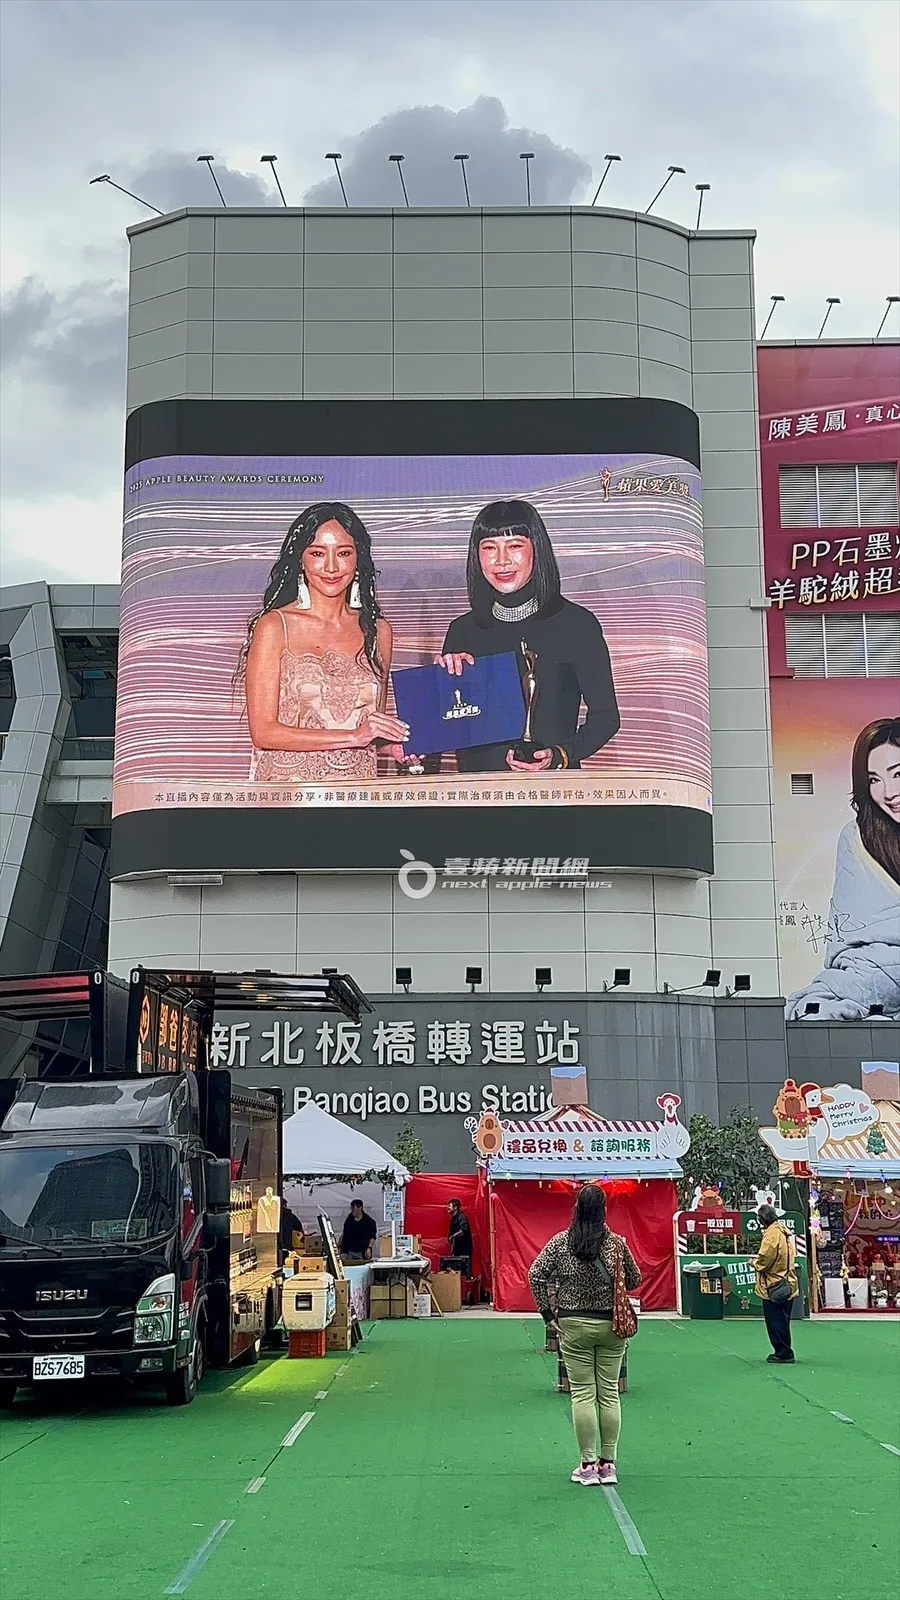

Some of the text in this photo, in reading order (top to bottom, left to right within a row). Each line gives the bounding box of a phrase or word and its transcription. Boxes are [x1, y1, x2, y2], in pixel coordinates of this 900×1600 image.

[145, 475, 172, 487] APPLE
[177, 474, 216, 483] BEAUTY
[220, 476, 263, 484] AWARDS
[267, 474, 324, 484] CEREMONY
[769, 566, 900, 610] 羊駝絨超
[779, 901, 809, 911] 代言人
[210, 1020, 580, 1067] 新北板橋轉運站
[293, 1086, 410, 1121] Banqiao
[418, 1085, 472, 1113] Bus
[482, 1084, 553, 1113] Stati
[830, 1111, 854, 1121] Merry
[831, 1115, 873, 1129] Christmas
[506, 1138, 651, 1154] 禮品兌換 & 諮詢服務
[36, 1289, 89, 1302] ISUZU
